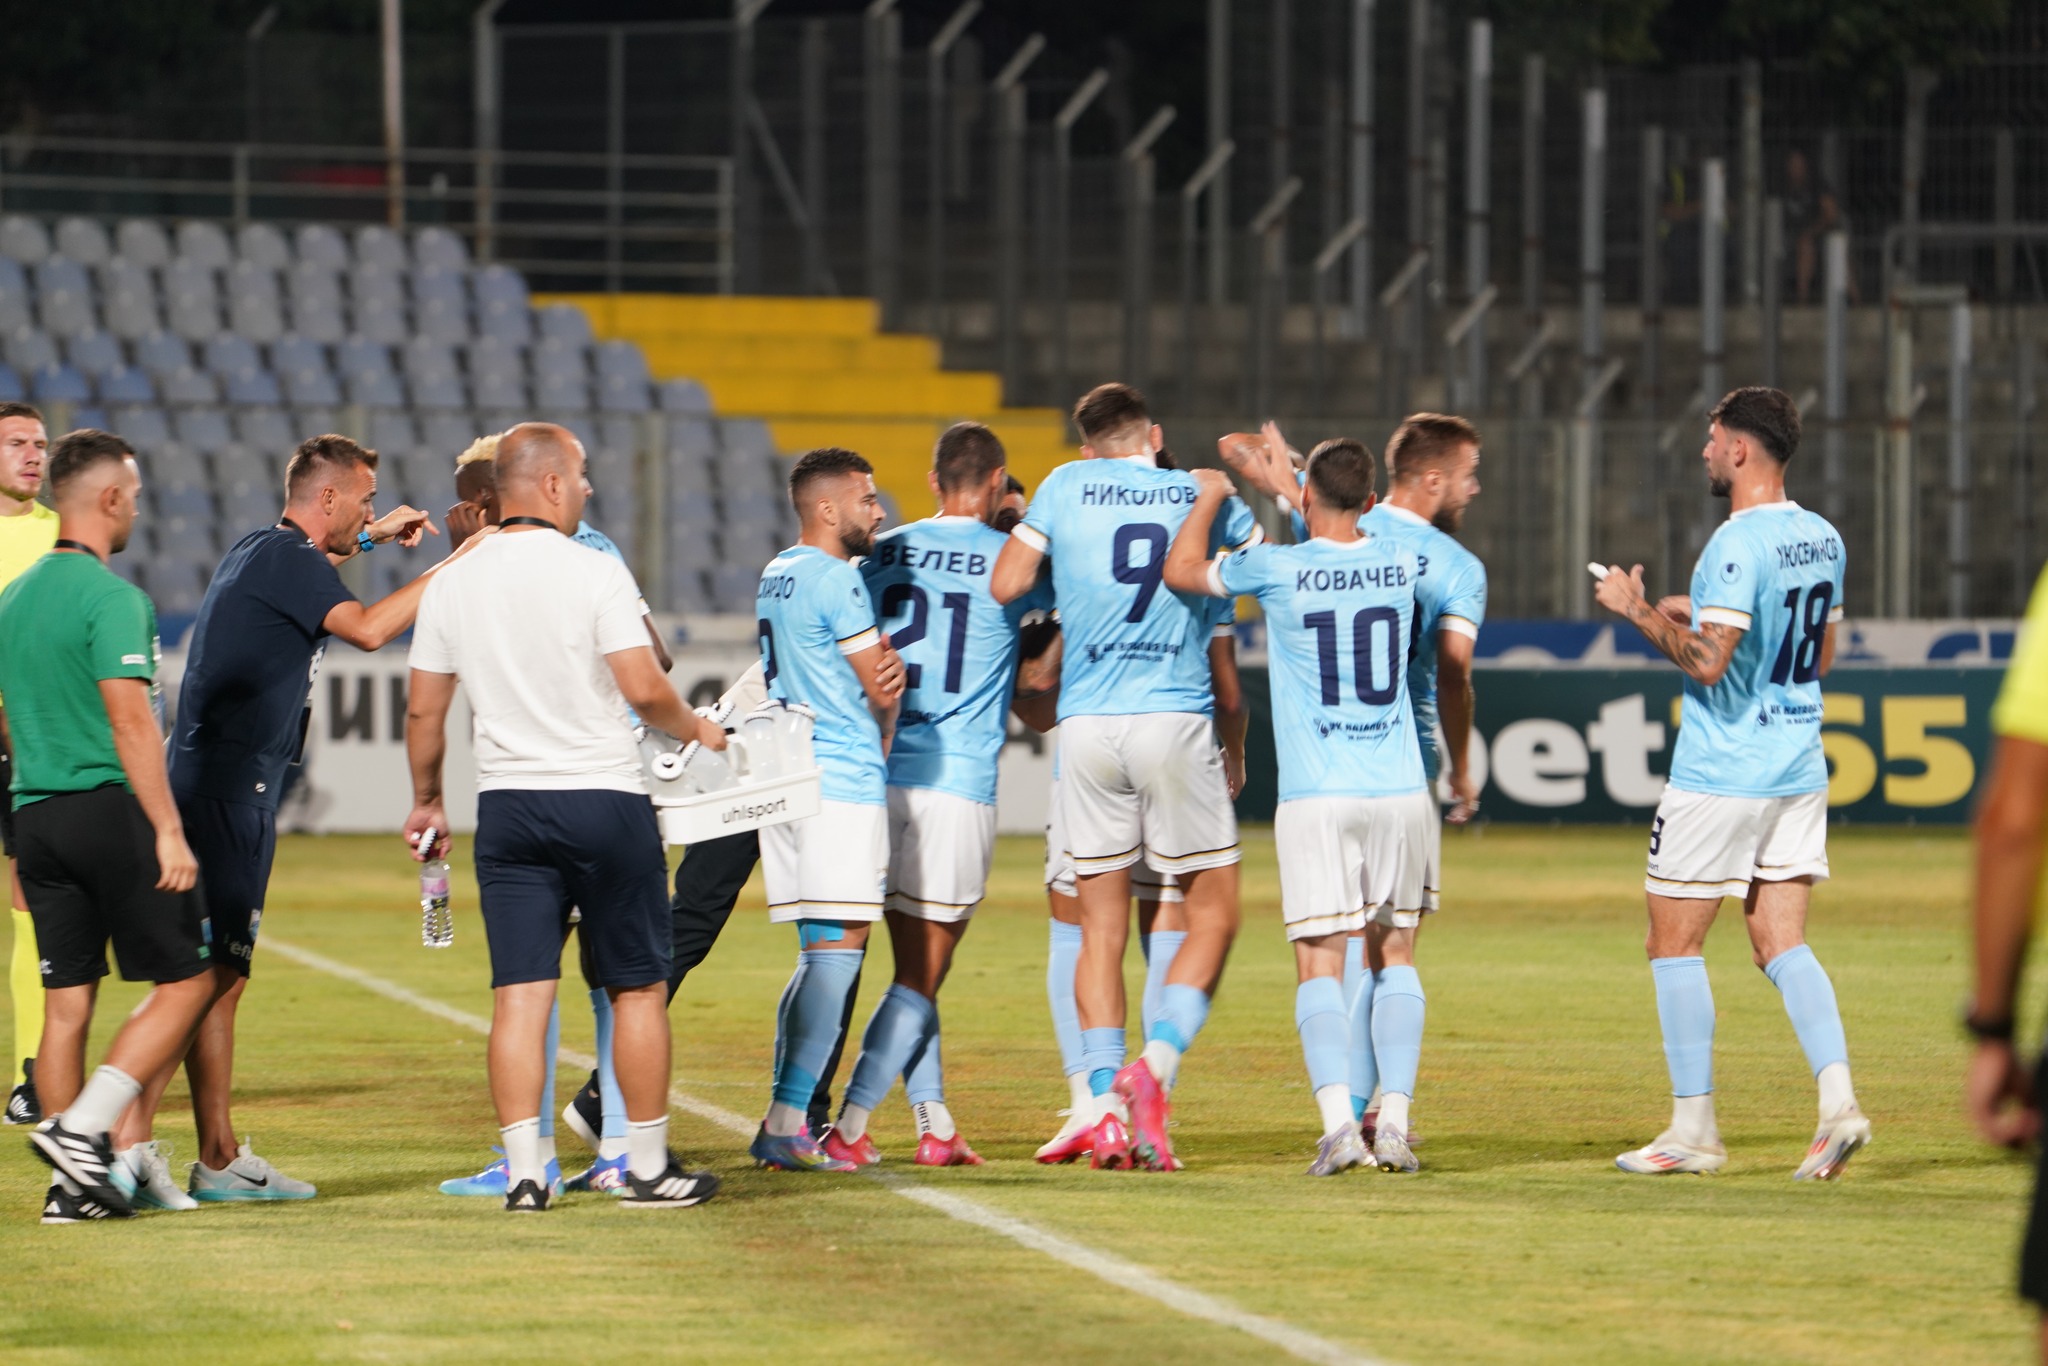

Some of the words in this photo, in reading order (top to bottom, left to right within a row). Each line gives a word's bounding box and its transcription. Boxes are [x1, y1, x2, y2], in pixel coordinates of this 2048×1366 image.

[1082, 483, 1197, 506] НИКОЛОВ
[880, 544, 987, 576] ВЕЛЕВ
[1112, 523, 1168, 624] 9
[1296, 566, 1408, 592] КОВАЧЕВ
[881, 583, 970, 694] 21
[1303, 606, 1401, 706] 10
[1769, 581, 1834, 687] 18
[721, 797, 787, 824] uhlsport
